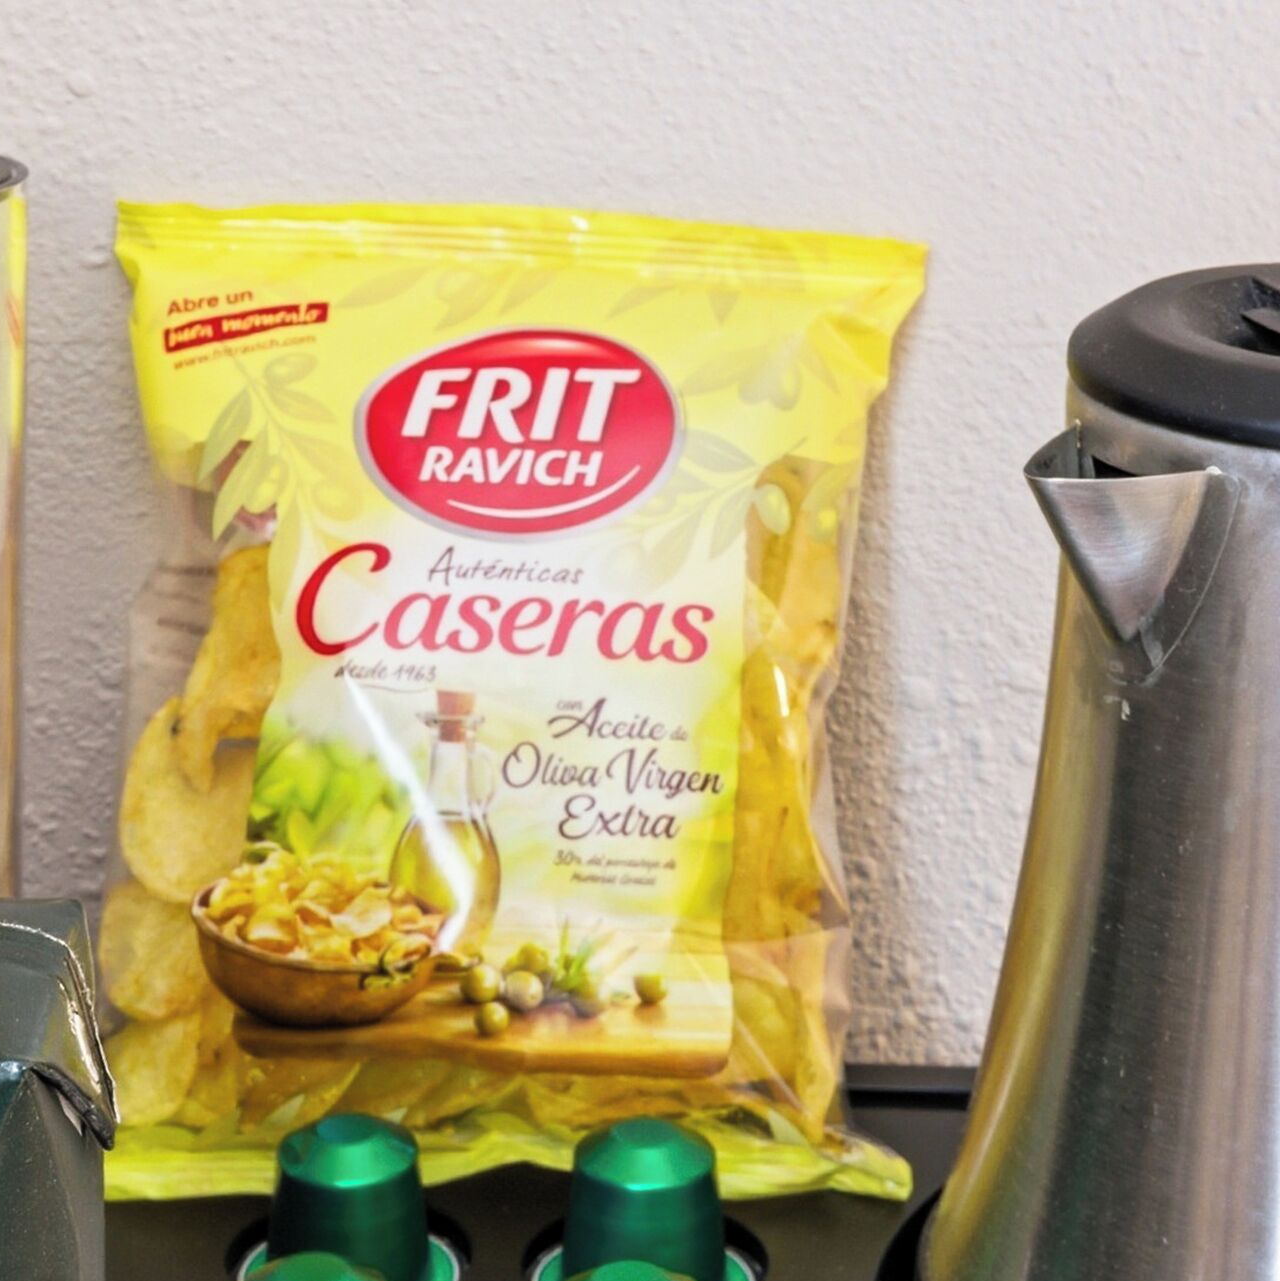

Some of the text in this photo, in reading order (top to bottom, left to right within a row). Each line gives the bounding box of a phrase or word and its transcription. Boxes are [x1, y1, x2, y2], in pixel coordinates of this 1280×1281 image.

[167, 290, 254, 316] Abre un
[400, 367, 642, 444] FRIT
[418, 447, 604, 488] RAVICH
[427, 545, 585, 587] Auténticas
[295, 541, 716, 664] Caseras
[394, 664, 437, 684] 1963
[548, 697, 666, 741] Aceite
[502, 741, 723, 799] Oliva Virgen
[558, 793, 680, 840] Extra
